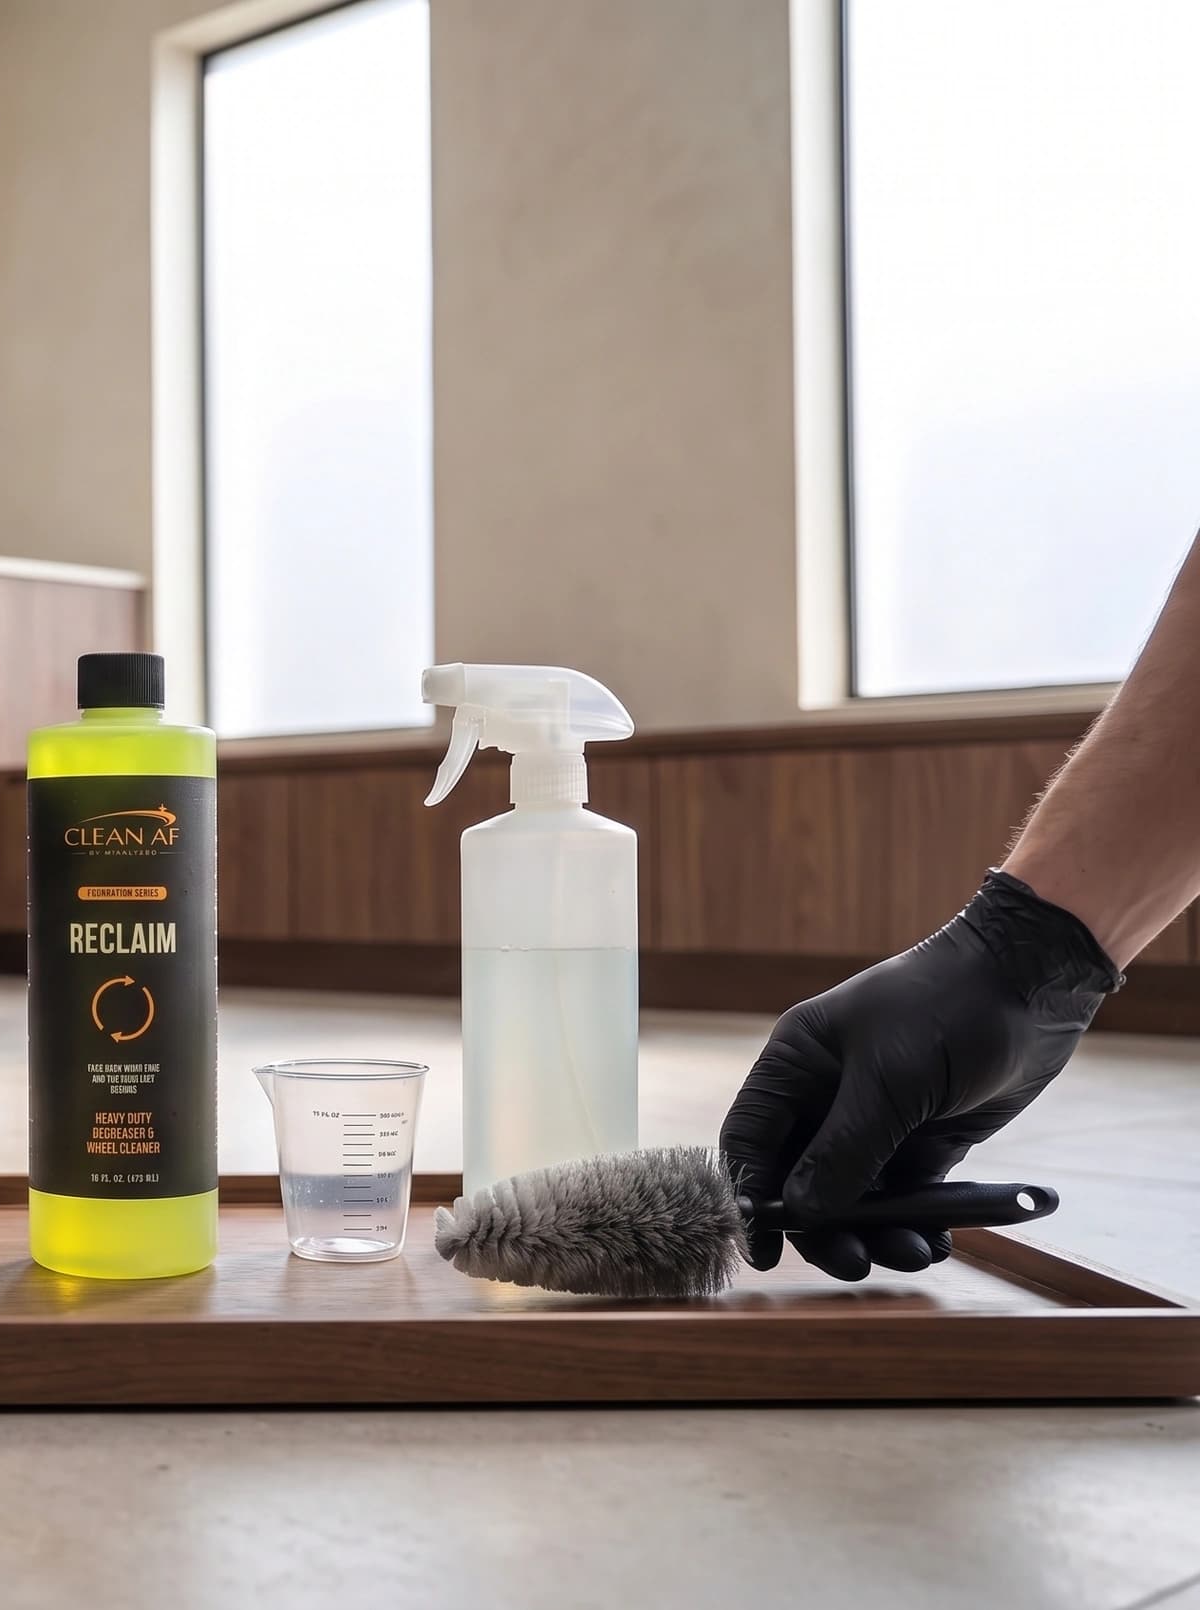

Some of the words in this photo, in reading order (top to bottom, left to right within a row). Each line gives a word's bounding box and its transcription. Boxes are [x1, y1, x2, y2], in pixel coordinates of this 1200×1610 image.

[64, 827, 143, 846] CLEAN
[150, 827, 180, 846] AF
[134, 888, 159, 897] SERIES
[70, 922, 176, 954] RECLAIM
[95, 1112, 126, 1125] HEAVY
[127, 1112, 153, 1125] DUTY
[92, 1127, 145, 1140] DEGREASER
[87, 1141, 118, 1154] WHEEL
[119, 1141, 161, 1154] CLEANER
